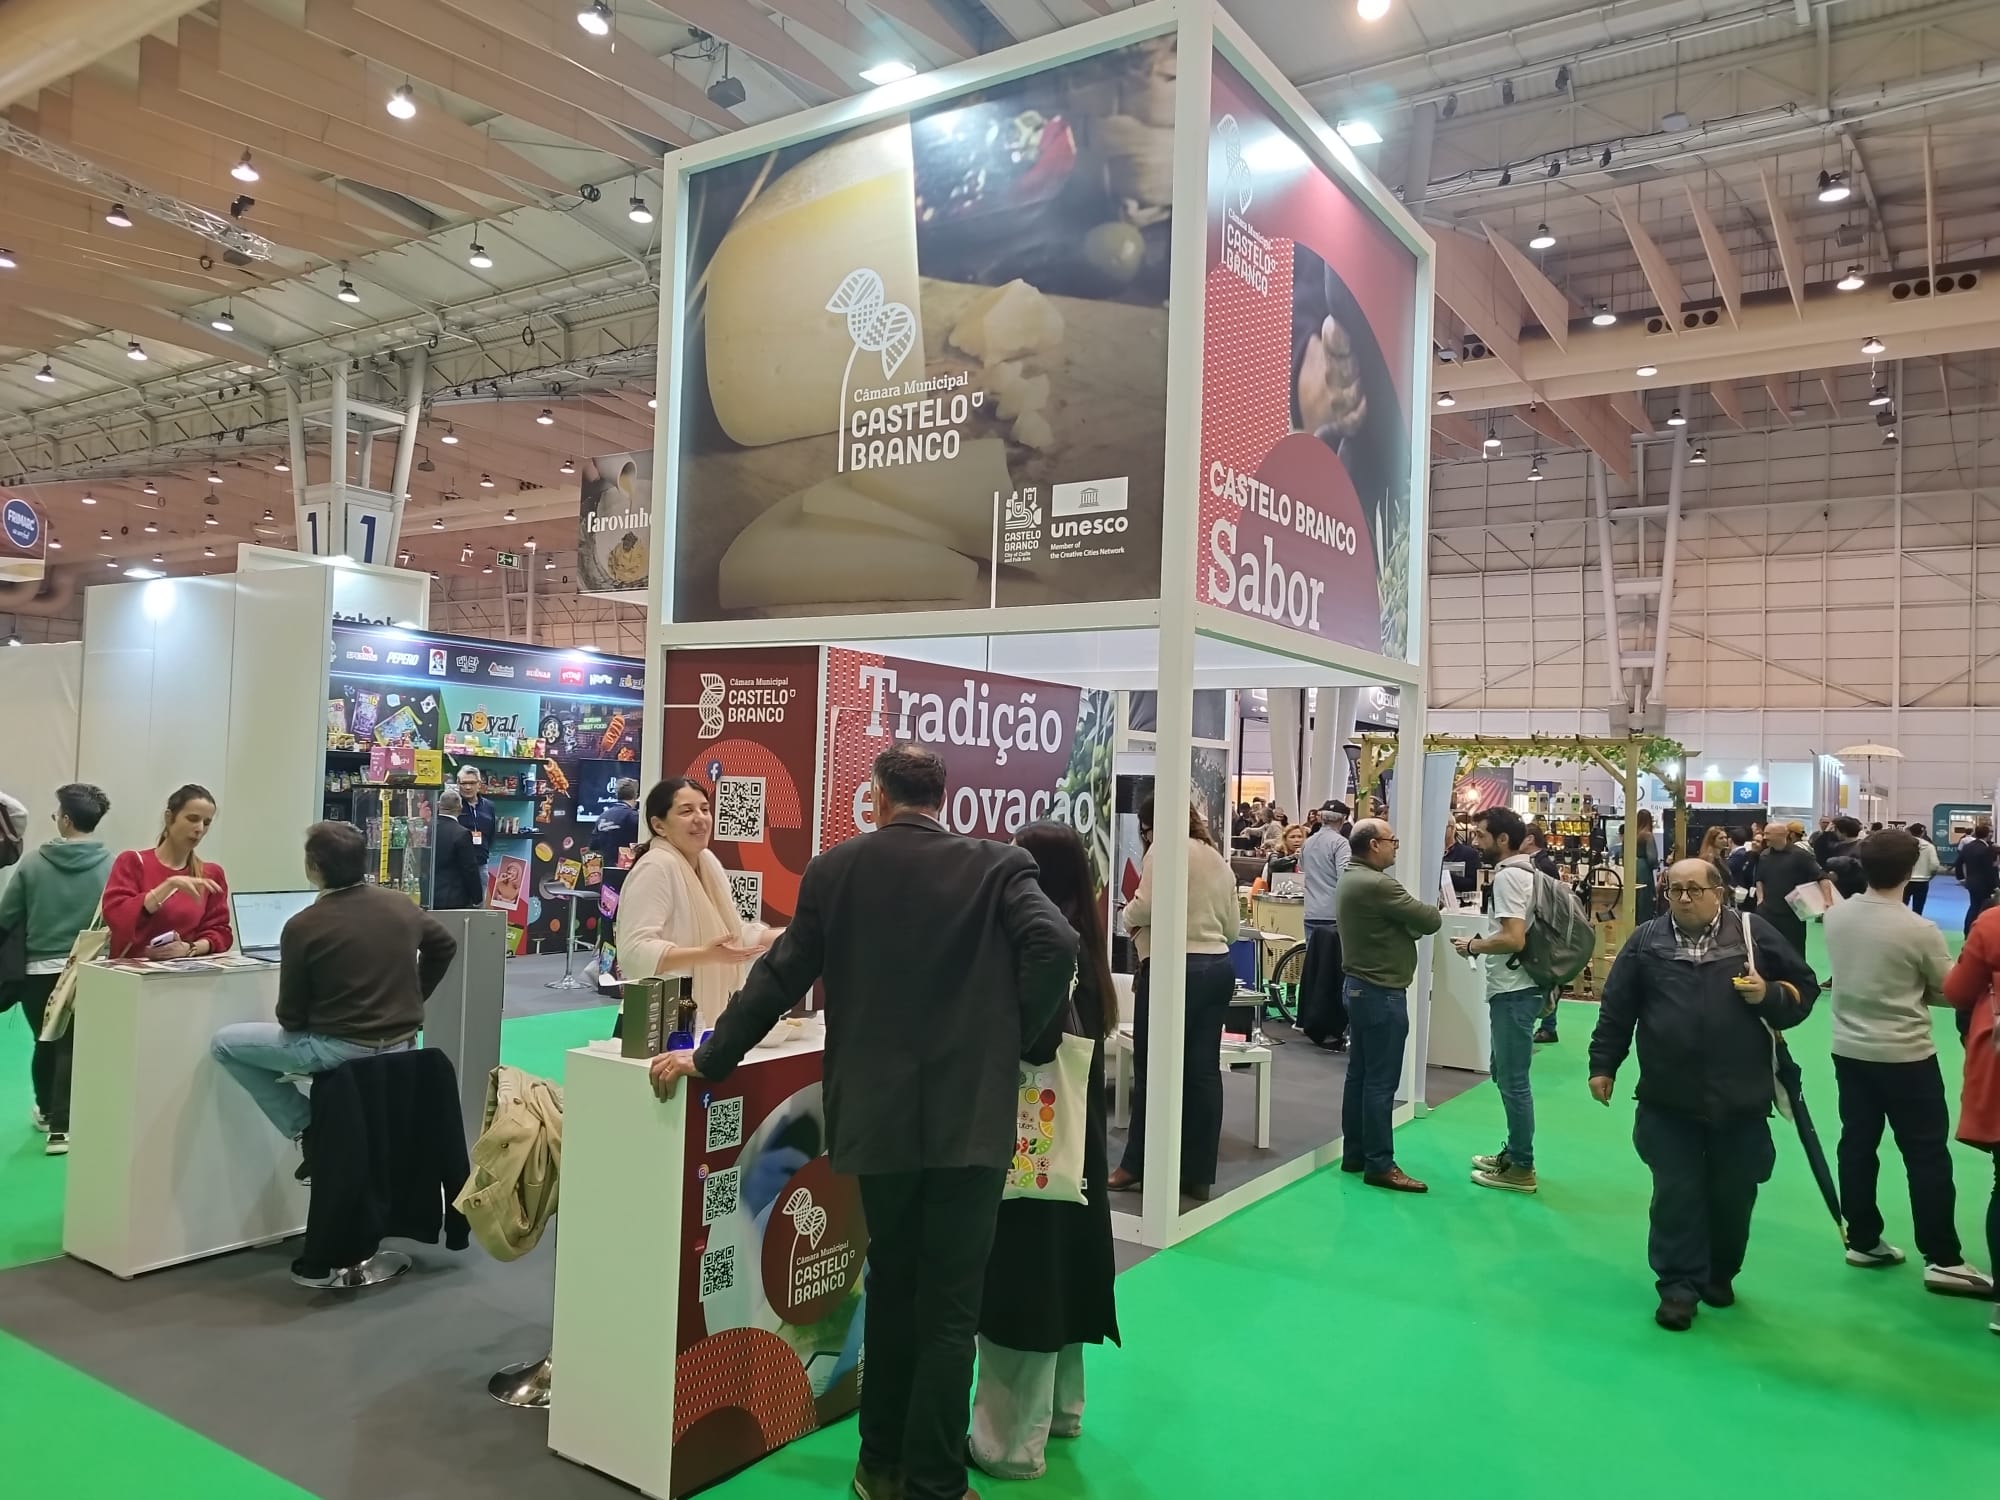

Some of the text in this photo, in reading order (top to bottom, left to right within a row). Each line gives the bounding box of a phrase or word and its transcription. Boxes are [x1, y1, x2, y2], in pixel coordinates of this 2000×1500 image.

[1227, 224, 1270, 274] CASTELO
[1227, 247, 1267, 296] BRANCO
[854, 371, 968, 402] Câmara Municipal
[851, 394, 968, 438] CASTELO
[851, 429, 960, 471] BRANCO
[587, 507, 652, 533] farovinh
[1209, 460, 1356, 555] CASTELO BRANCO
[307, 512, 318, 555] 1
[360, 515, 376, 563] 1
[1004, 530, 1041, 541] CASTELO
[1050, 516, 1129, 538] unesco
[1004, 540, 1039, 552] BRANCO
[1050, 541, 1081, 550] Member of
[1050, 546, 1125, 559] the Creative Cities Network
[1208, 518, 1324, 631] Sabor
[386, 652, 419, 665] PEPERO
[728, 689, 788, 705] CASTELO
[730, 677, 788, 686] Câmara Municipal
[728, 707, 784, 722] BRANCO
[858, 664, 1063, 766] Tradição
[796, 1240, 849, 1266] Câmara Municipal
[795, 1252, 849, 1286] CASTELO
[794, 1271, 845, 1305] BRANCO
